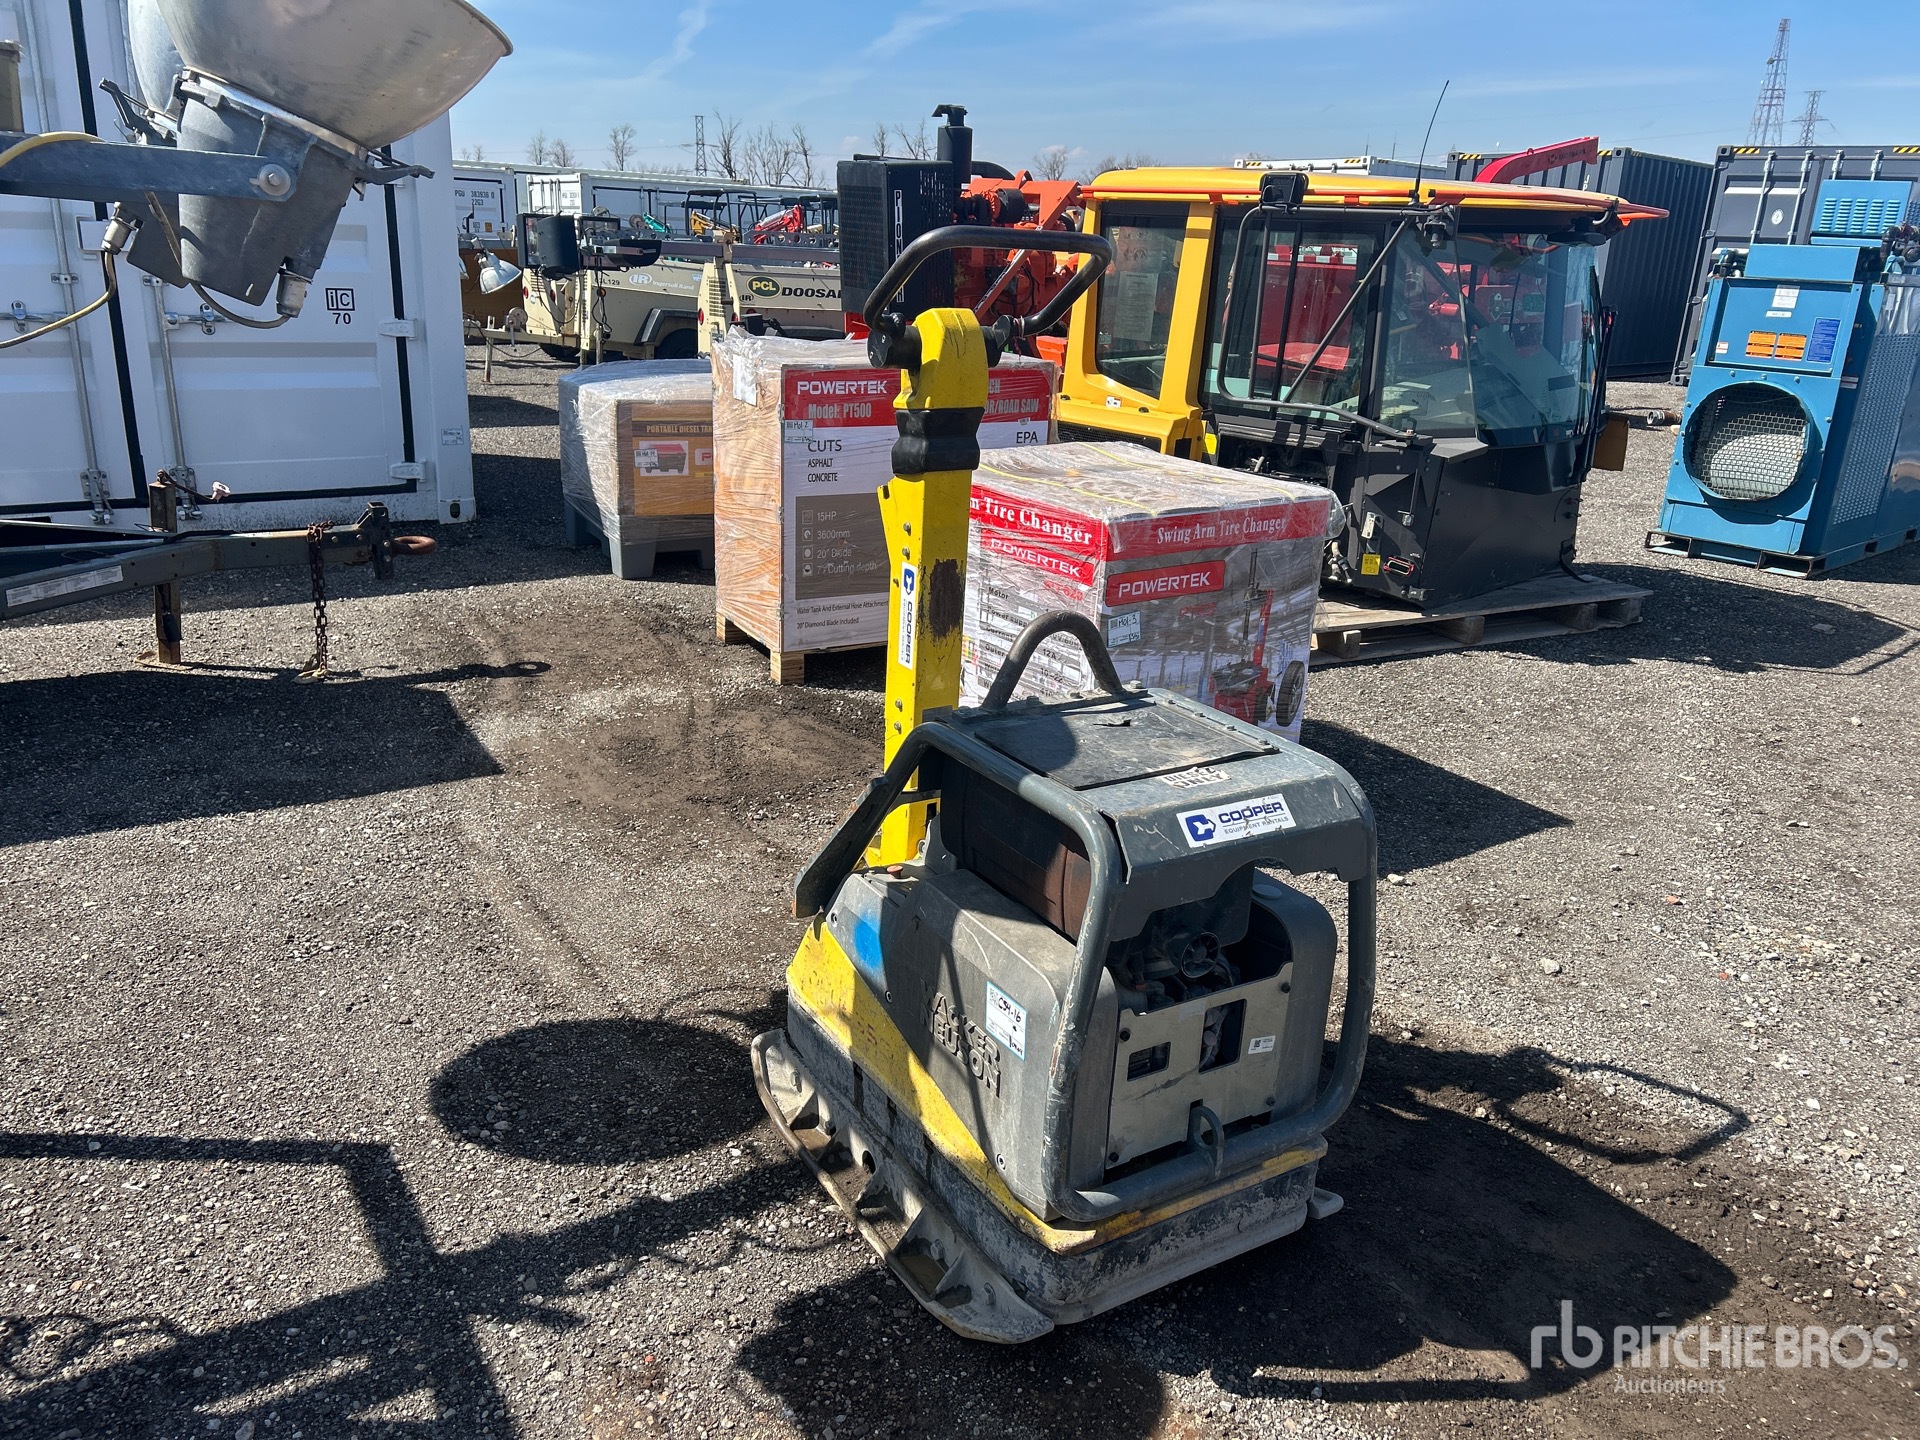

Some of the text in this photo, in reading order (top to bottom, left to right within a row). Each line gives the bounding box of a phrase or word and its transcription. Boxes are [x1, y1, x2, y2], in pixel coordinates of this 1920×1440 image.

[652, 280, 695, 290] Ingersoll Rand
[752, 281, 776, 291] PCL
[332, 312, 352, 325] 70
[797, 380, 888, 395] POWERTEK
[808, 402, 872, 419] Model: PT500
[1020, 398, 1040, 413] SAW
[646, 425, 679, 433] PORTABLE
[679, 425, 701, 433] DIESEL
[1016, 431, 1039, 444] EPA
[807, 439, 843, 453] CUTS
[807, 458, 834, 468] ASPHALT
[807, 472, 838, 483] CONCRETE
[816, 510, 837, 521] 15HP
[983, 497, 1016, 522] Tire
[1019, 508, 1093, 545] Changer
[1157, 516, 1287, 545] Swing Arm Tire Changer
[989, 538, 1081, 577] POWERTEK
[1118, 571, 1211, 598] POWERTEK
[988, 586, 1009, 600] Motor
[822, 604, 832, 612] And
[832, 603, 851, 611] External
[804, 620, 826, 629] Diamond
[826, 619, 839, 627] Blade
[905, 601, 913, 664] COOPER
[1042, 648, 1058, 660] 12A
[1164, 767, 1217, 782] DIESEL
[1218, 801, 1285, 824] COOPER
[1224, 816, 1289, 835] EQUIPMENT RENTALS
